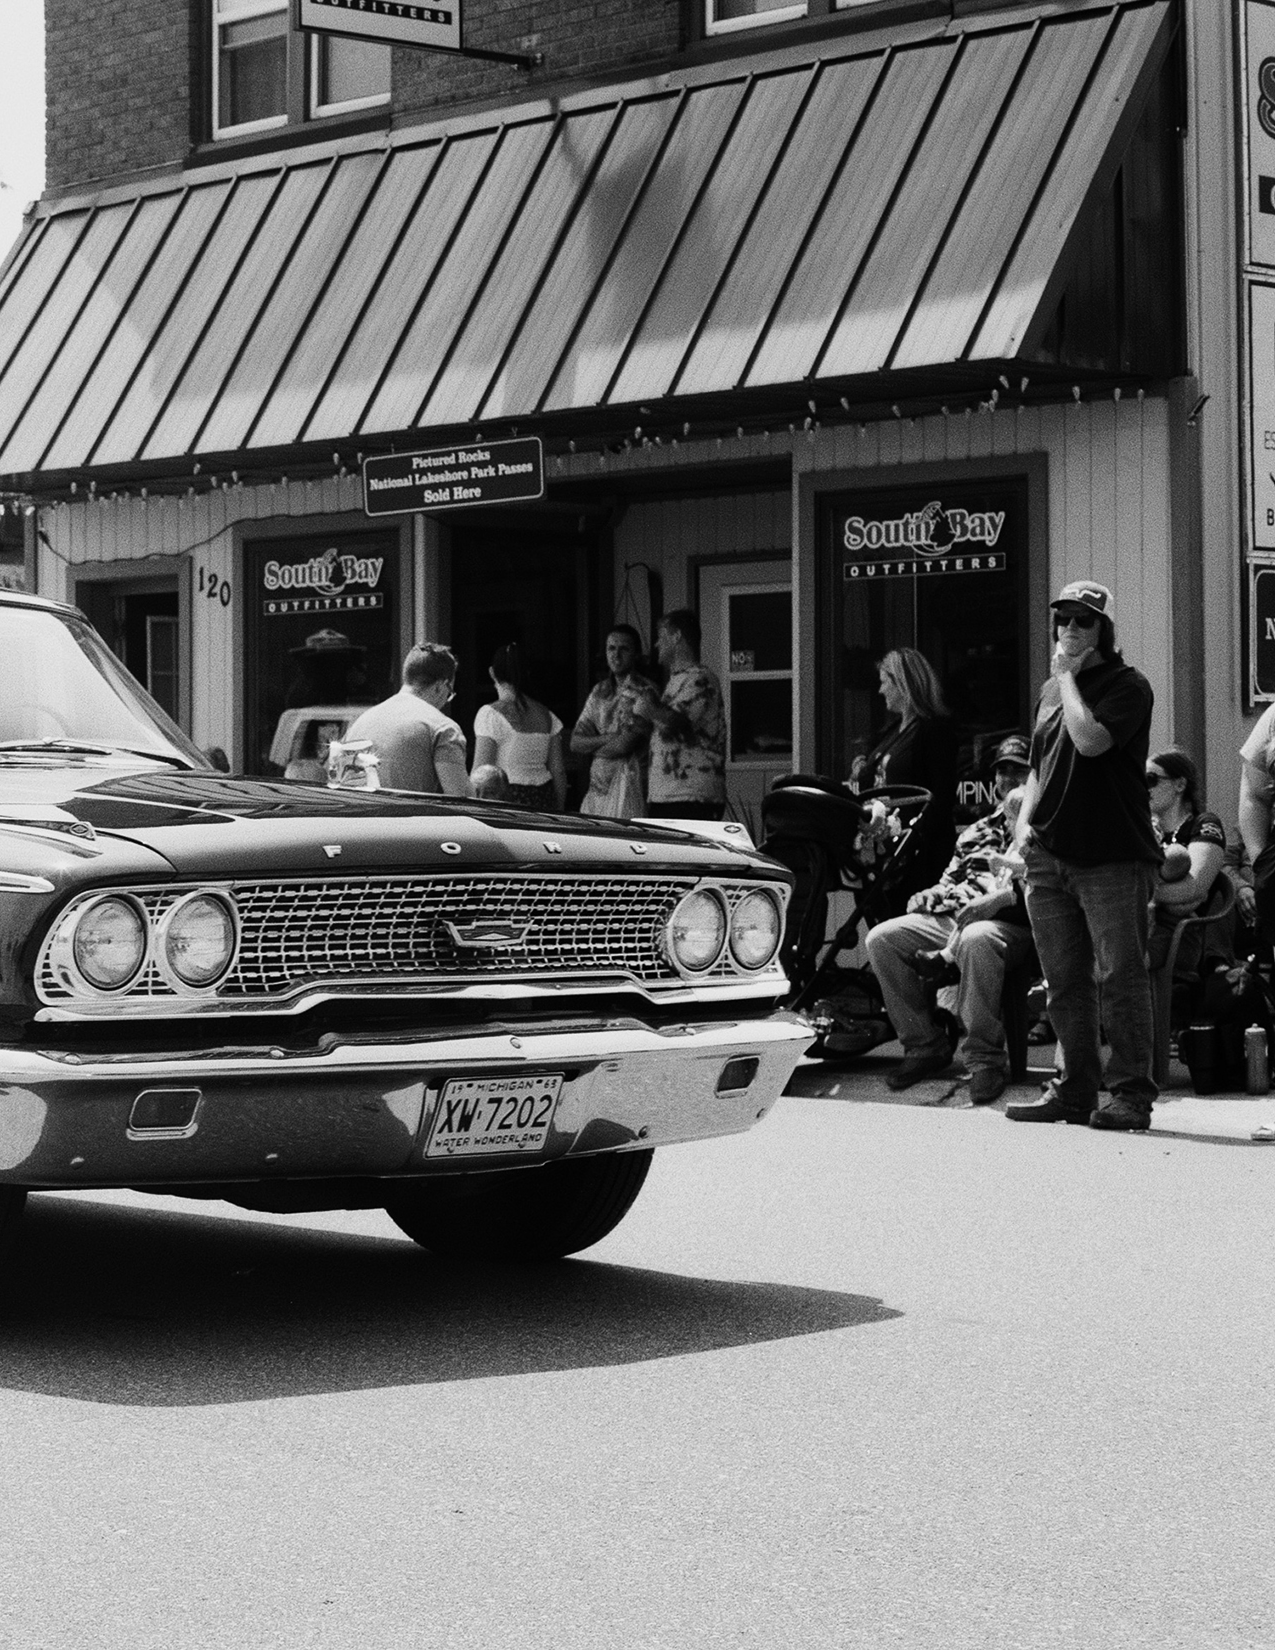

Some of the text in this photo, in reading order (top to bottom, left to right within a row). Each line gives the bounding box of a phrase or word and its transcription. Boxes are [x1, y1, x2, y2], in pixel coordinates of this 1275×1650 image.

[411, 449, 491, 469] Pictured Rocks
[369, 461, 534, 491] National Lakeshore Park Passes
[424, 485, 482, 503] Sold Here
[844, 508, 1006, 550] South Bay
[340, 555, 384, 588] Bay
[850, 556, 998, 577] OUTFITTERS
[199, 566, 231, 608] 120
[268, 597, 377, 614] OUTFITTERS
[323, 841, 649, 859] FORD
[476, 1080, 534, 1093] MICHIGAN
[435, 1132, 543, 1148] WATER WONDERLAND
